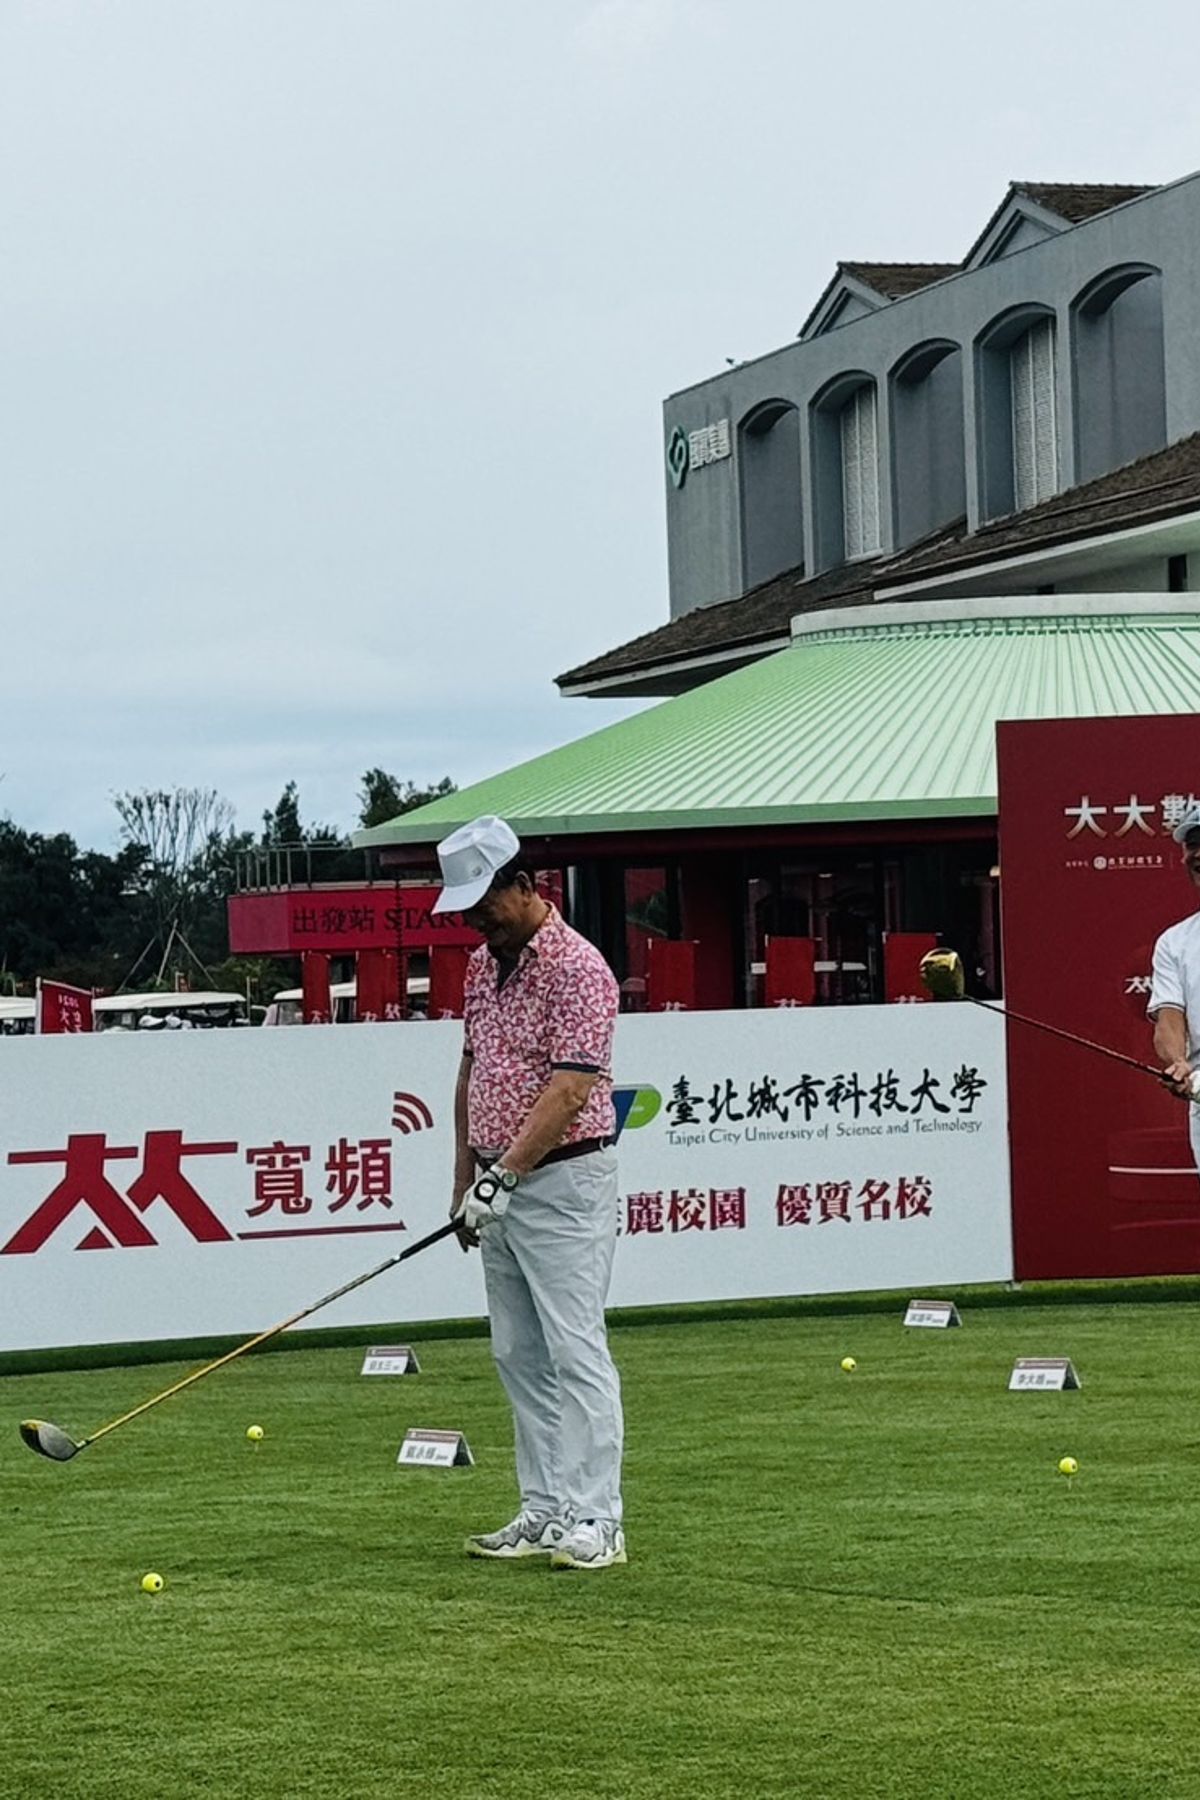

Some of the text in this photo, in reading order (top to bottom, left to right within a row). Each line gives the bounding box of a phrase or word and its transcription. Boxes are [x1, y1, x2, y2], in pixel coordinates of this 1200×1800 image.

[665, 1063, 988, 1127] 臺北城市科技大學
[666, 1117, 982, 1147] Taipei City University of Science and Technology
[616, 1175, 934, 1236] 麗校園 優質名校
